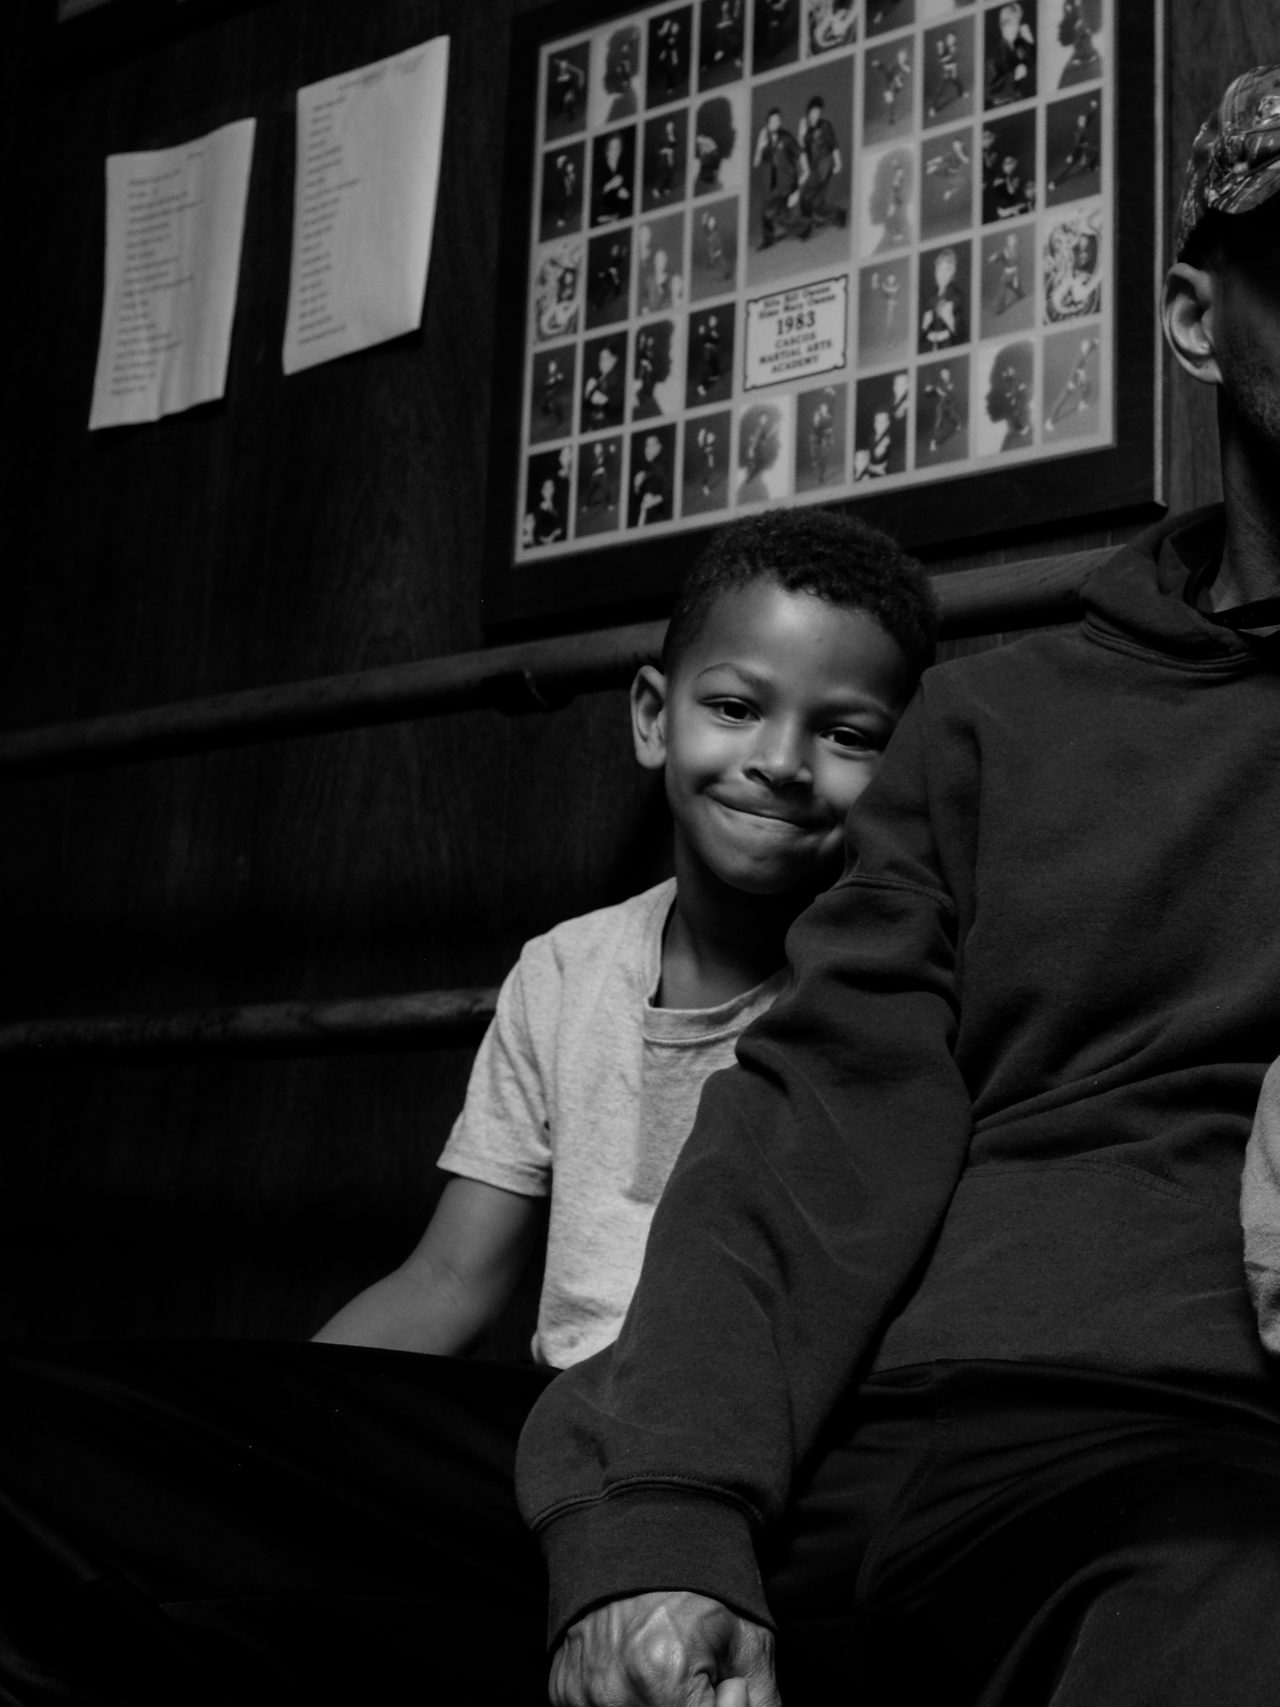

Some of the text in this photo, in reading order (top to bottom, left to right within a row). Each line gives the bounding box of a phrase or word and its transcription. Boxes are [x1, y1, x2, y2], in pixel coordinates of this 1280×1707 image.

[777, 309, 816, 335] 1983
[758, 338, 832, 364] MARTIAL ARTS
[771, 354, 819, 374] ACADEMY
